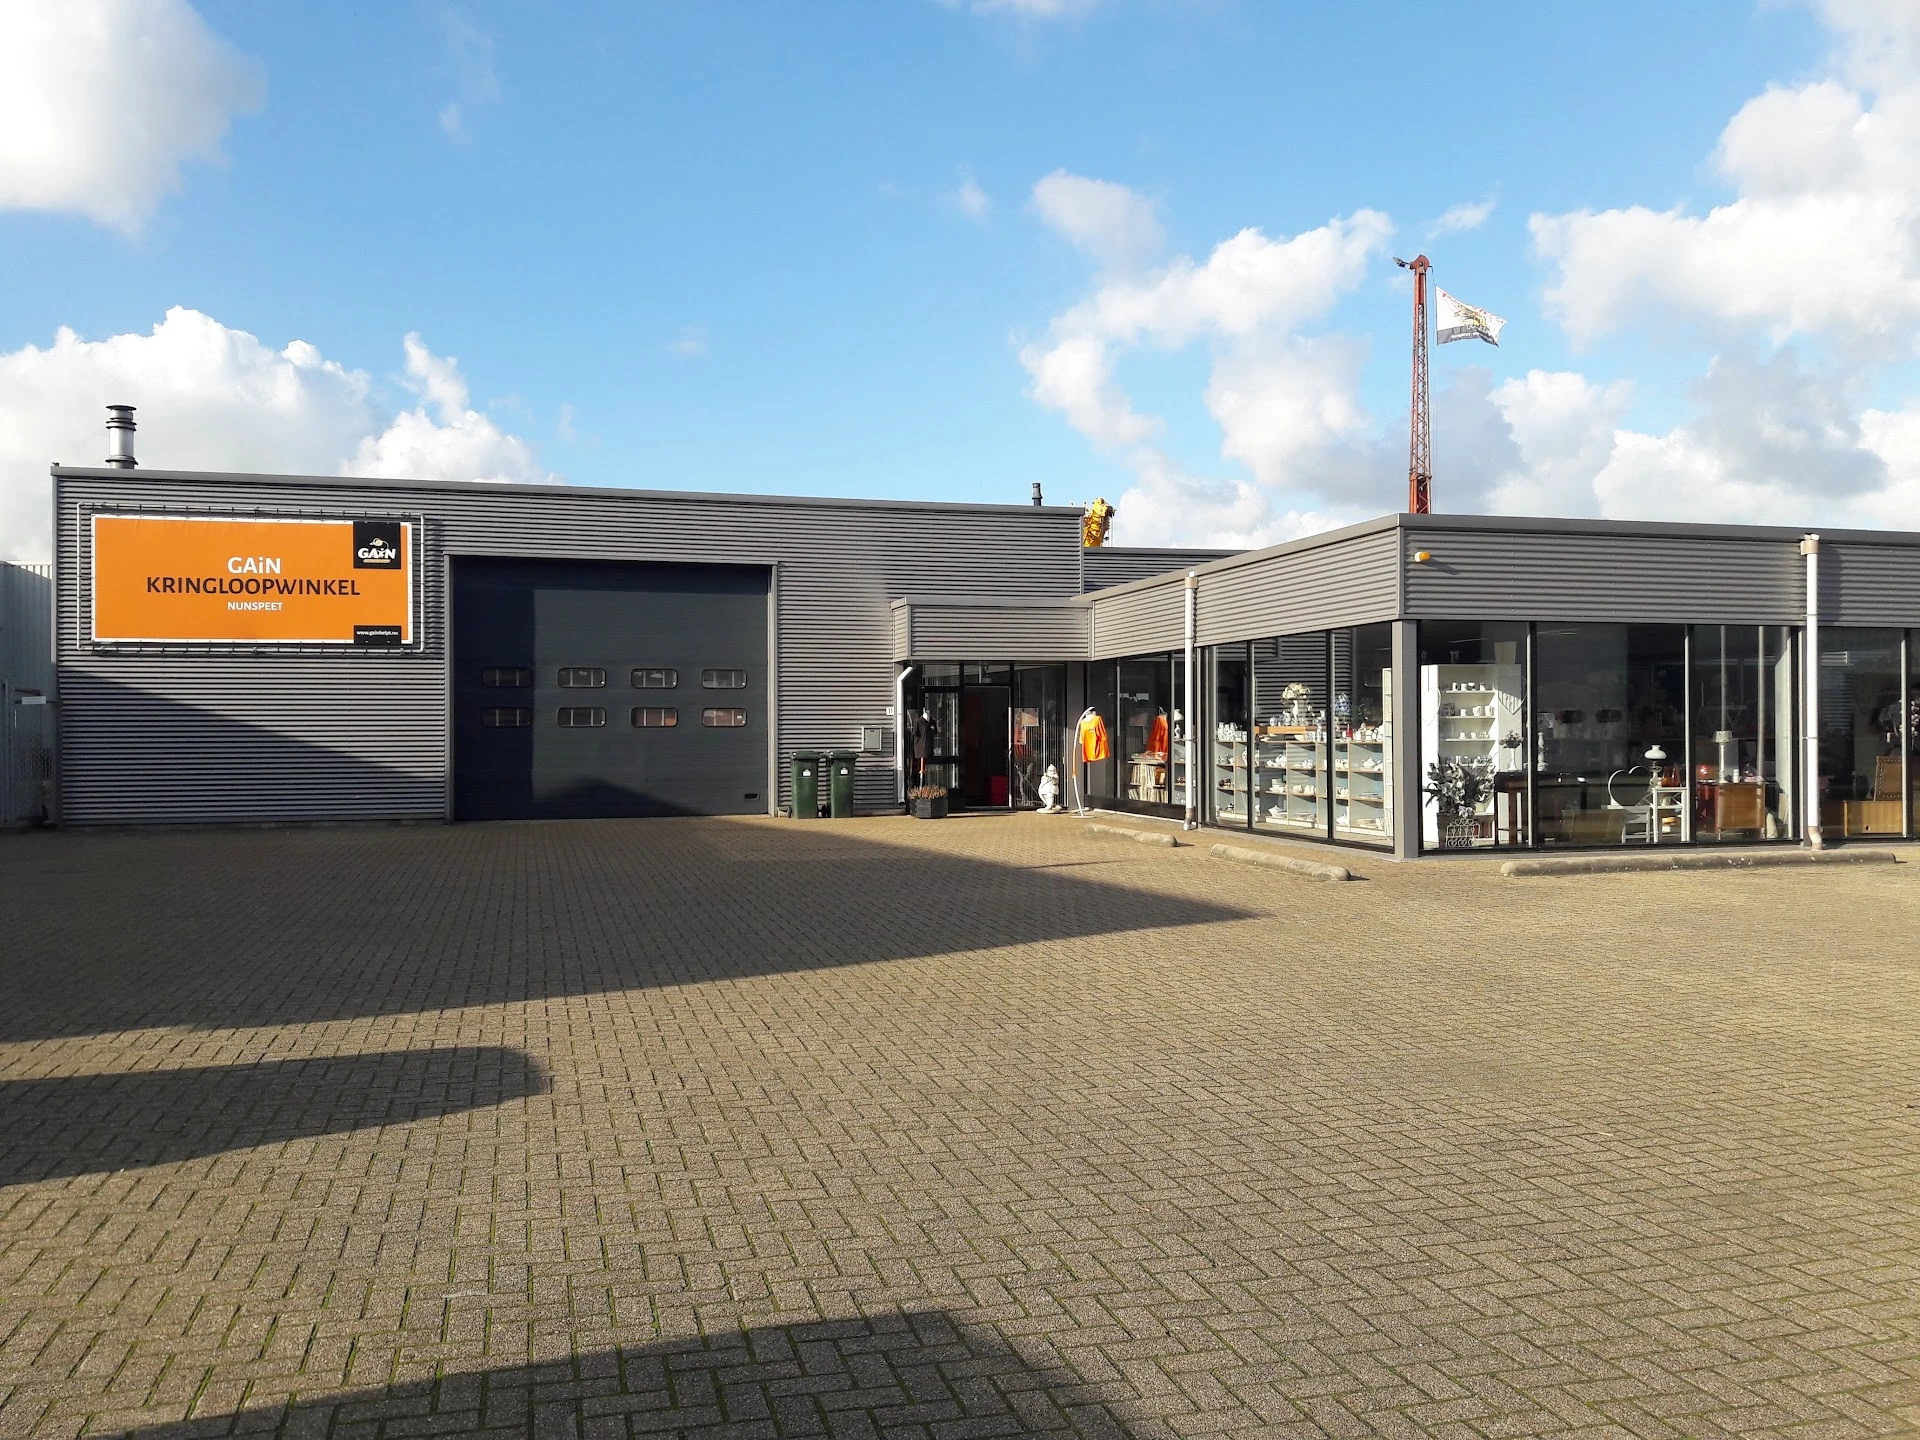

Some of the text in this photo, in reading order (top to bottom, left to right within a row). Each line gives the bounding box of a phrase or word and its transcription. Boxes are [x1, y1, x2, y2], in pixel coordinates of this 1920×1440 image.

[357, 547, 396, 559] GAiN
[227, 556, 281, 574] GAiN
[147, 577, 360, 595] KRINGLOOPWINKEL
[227, 601, 283, 611] NUNSPEET
